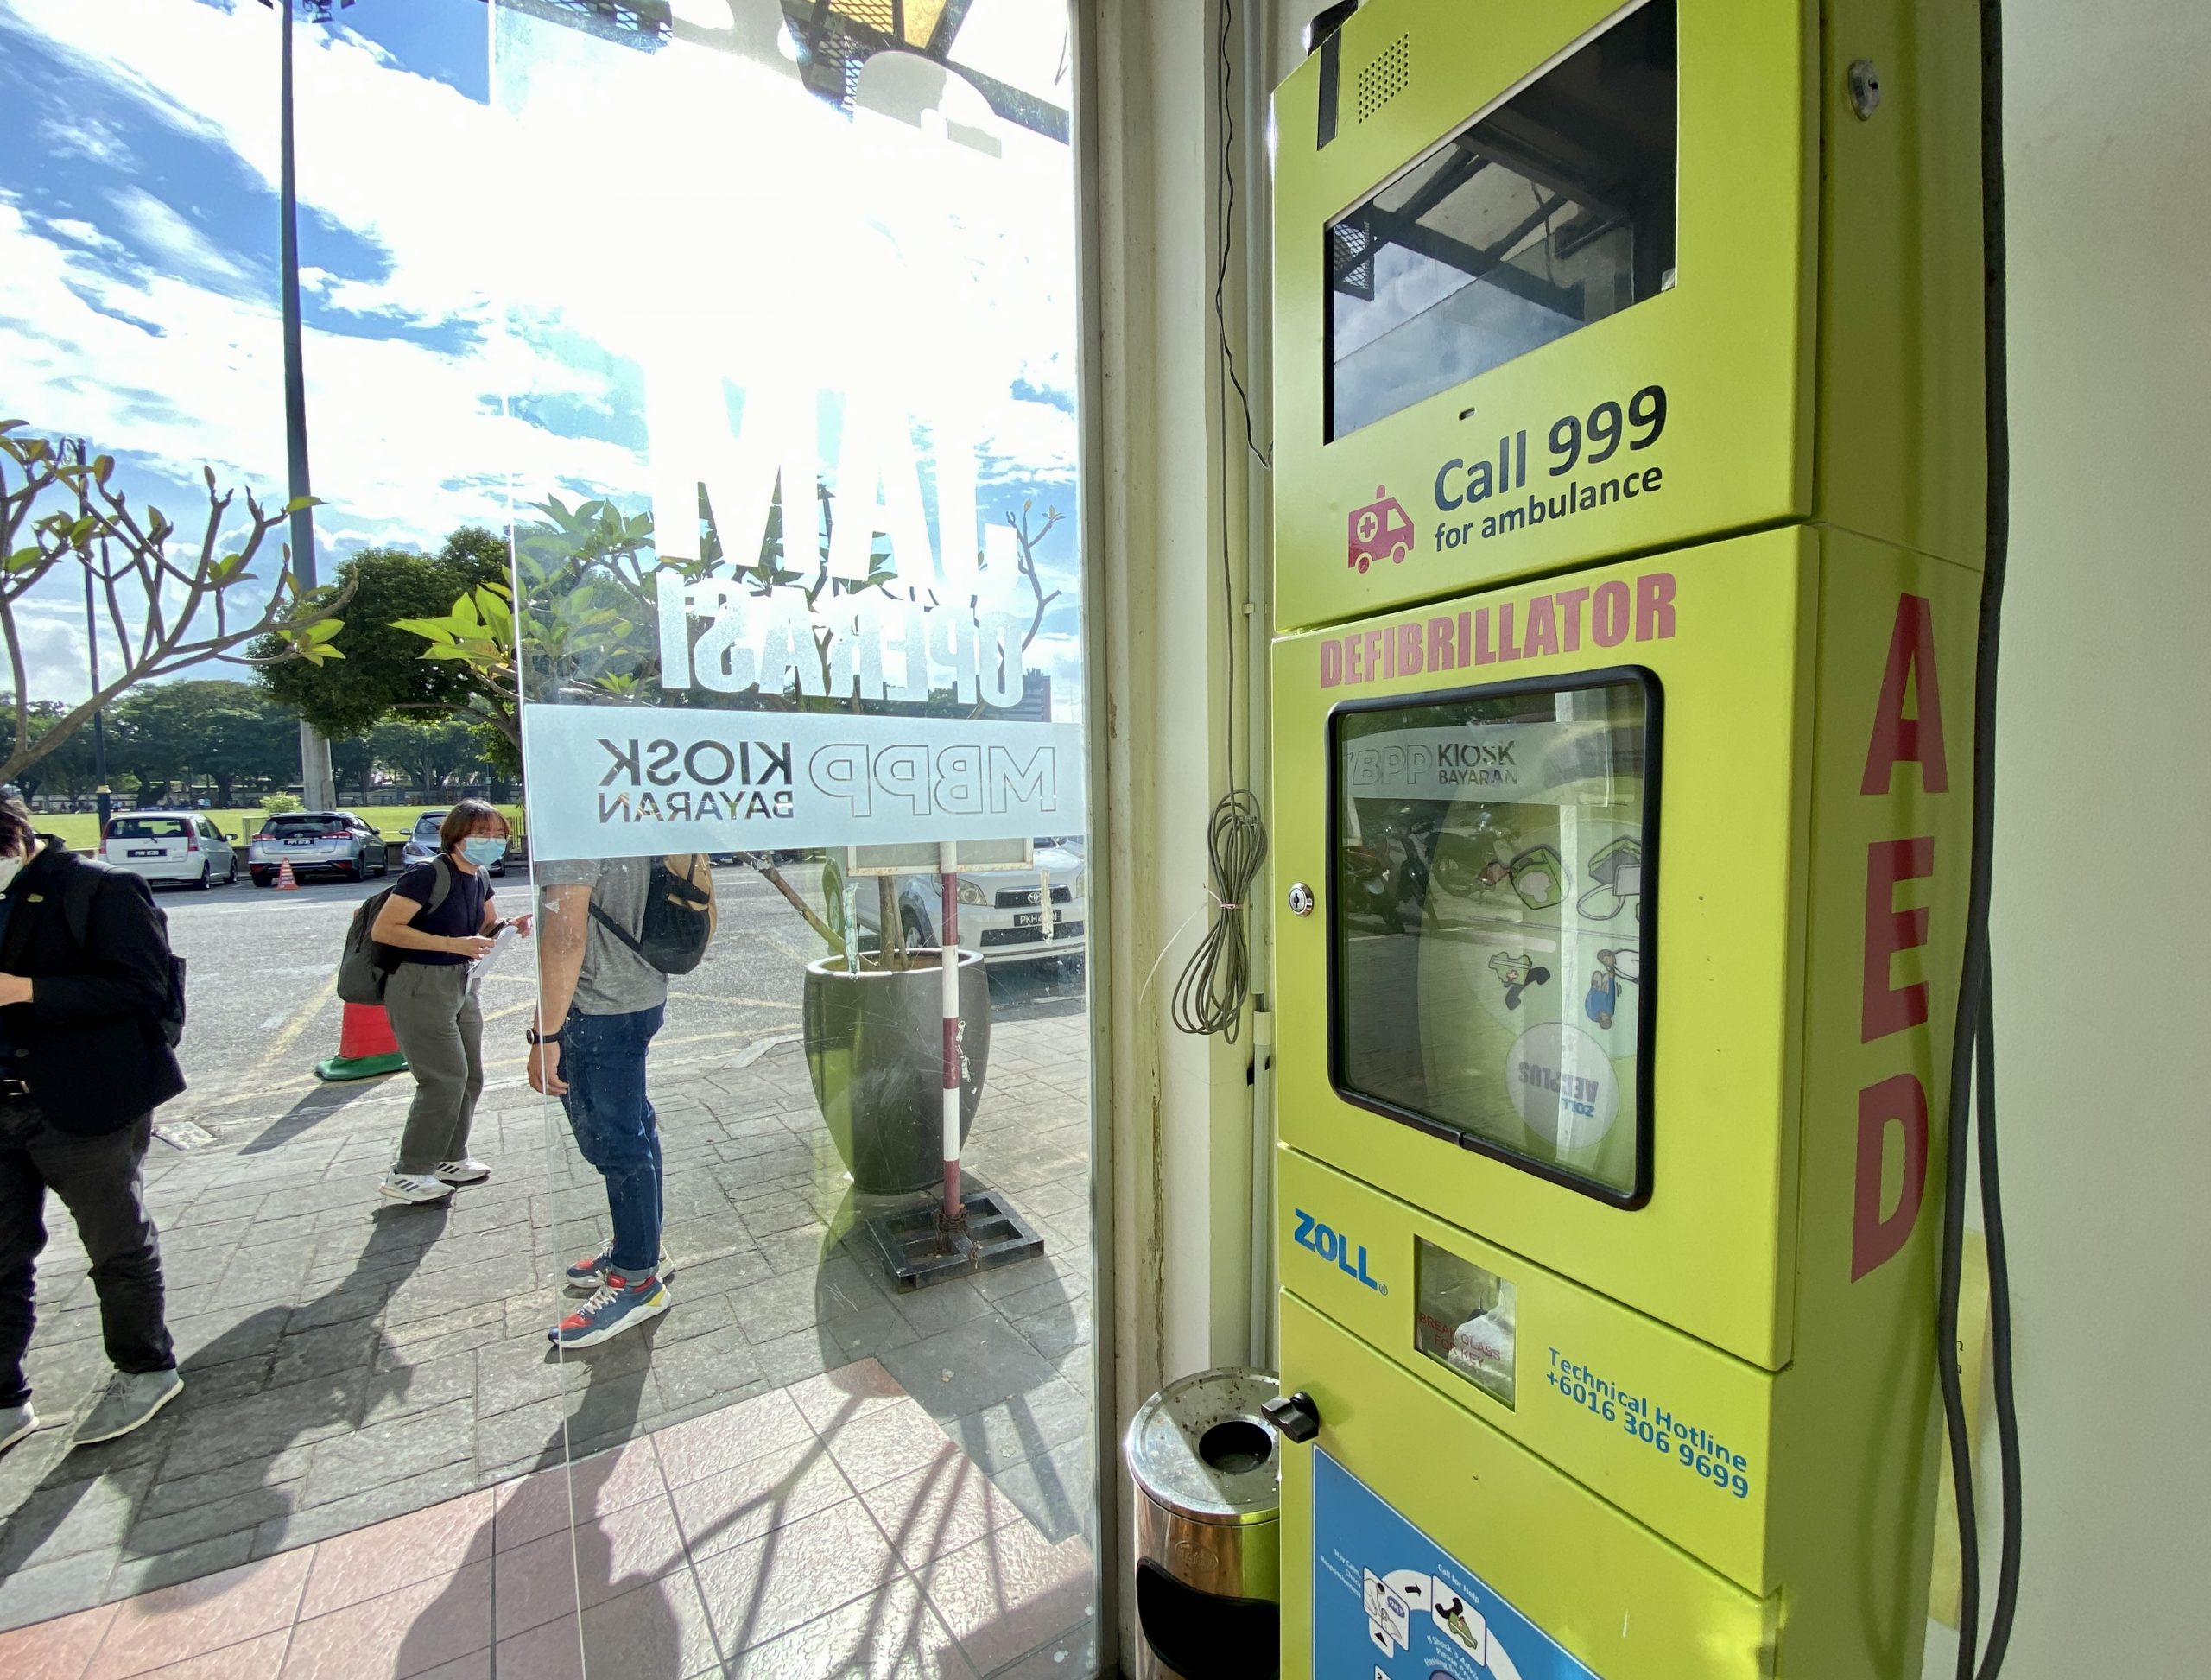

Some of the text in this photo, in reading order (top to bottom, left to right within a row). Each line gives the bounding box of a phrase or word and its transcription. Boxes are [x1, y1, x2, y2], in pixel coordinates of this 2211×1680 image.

[1435, 384, 1668, 512] Call 999
[1435, 466, 1663, 553] for ambulance
[1320, 572, 1676, 688] DEFIBRILLATOR
[1437, 740, 1518, 768] KIOSK
[1438, 768, 1518, 785] BAYARAN
[1850, 593, 1949, 1285] AED
[1418, 1313, 1502, 1362] BREAK GLASS
[1435, 1334, 1485, 1368] FOR KEY
[1546, 1371, 1749, 1499] +6016 306 9699
[1548, 1346, 1748, 1474] Technical Hotline
[1438, 1563, 1451, 1579] Call
[1463, 1584, 1480, 1604] Help
